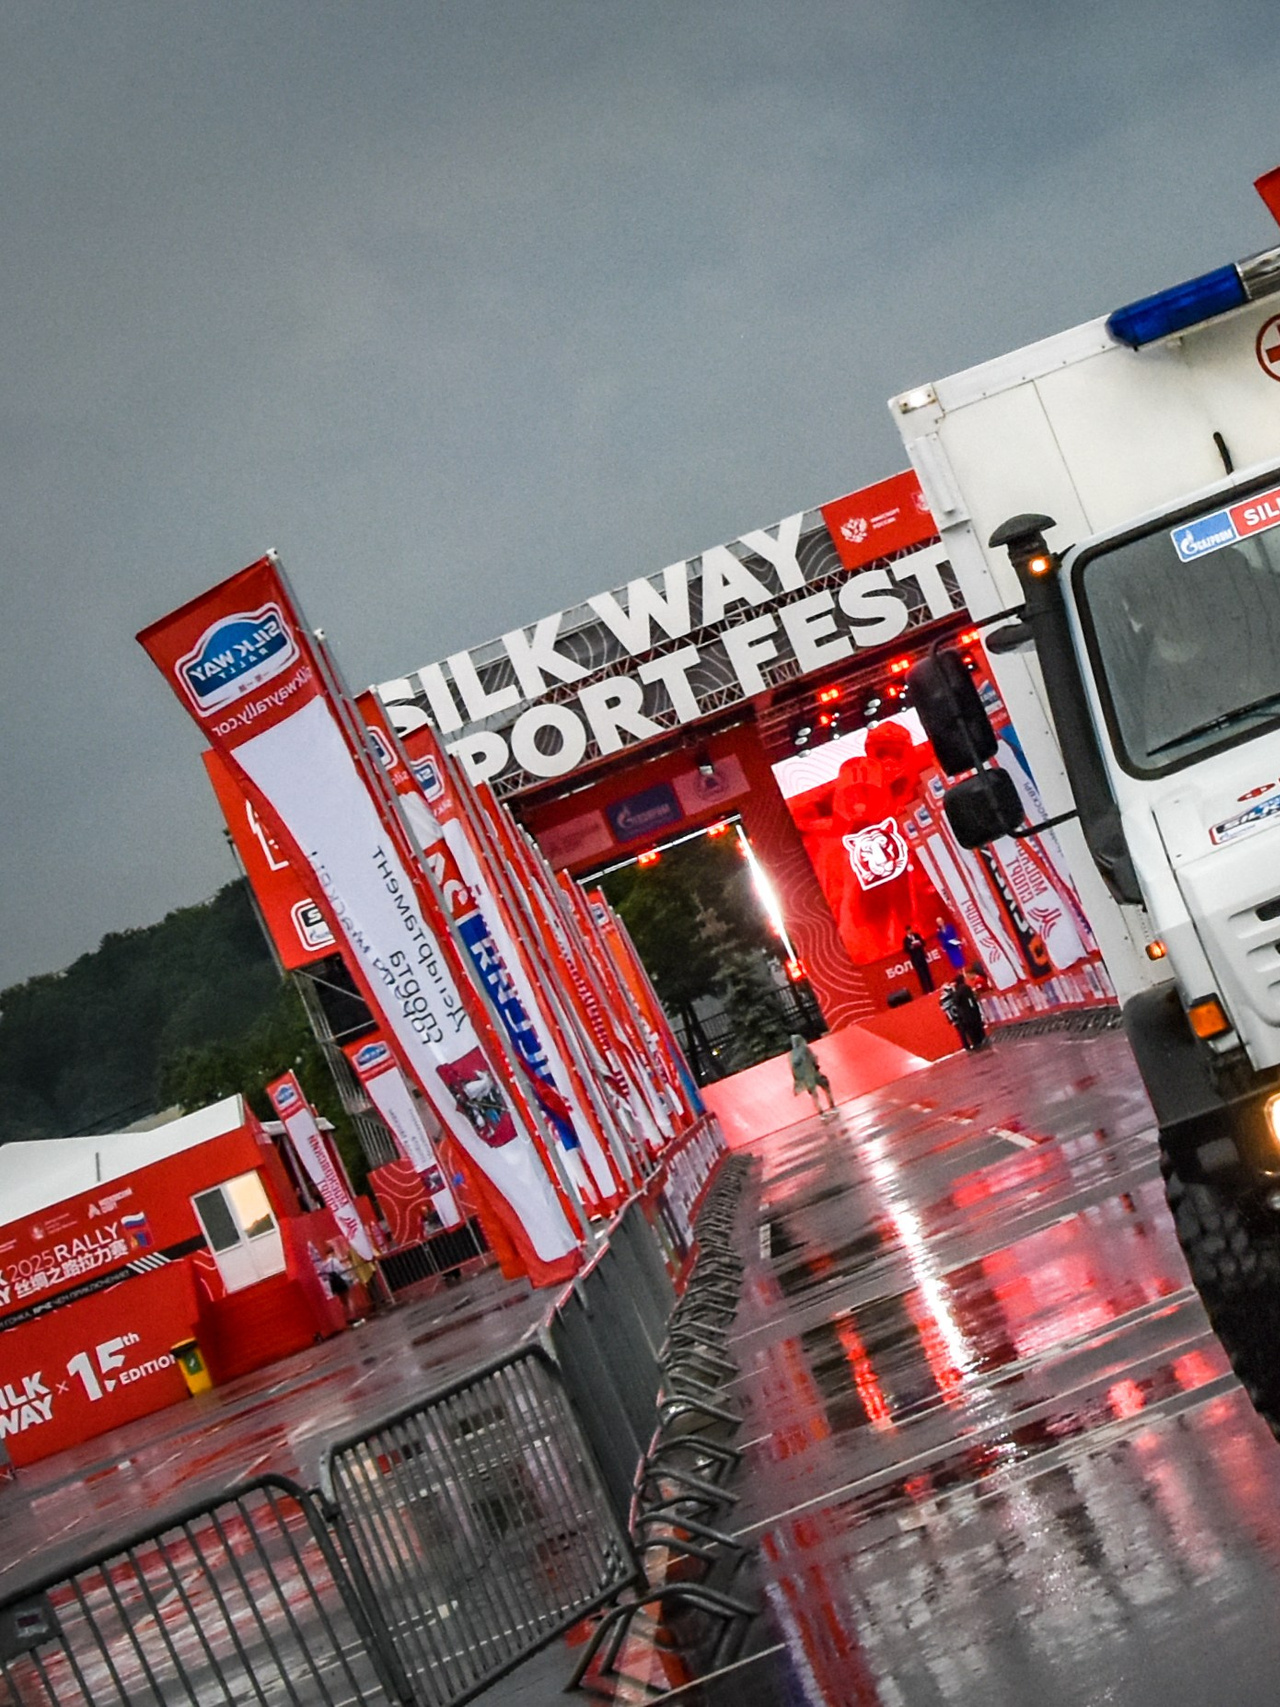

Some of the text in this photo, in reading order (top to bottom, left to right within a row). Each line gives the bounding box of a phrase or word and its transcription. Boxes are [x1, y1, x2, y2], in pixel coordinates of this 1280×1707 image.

[378, 512, 806, 738] SILK WAY
[446, 541, 957, 786] PORT FEST
[7, 1250, 55, 1282] 2025
[54, 1222, 119, 1262] RALLY
